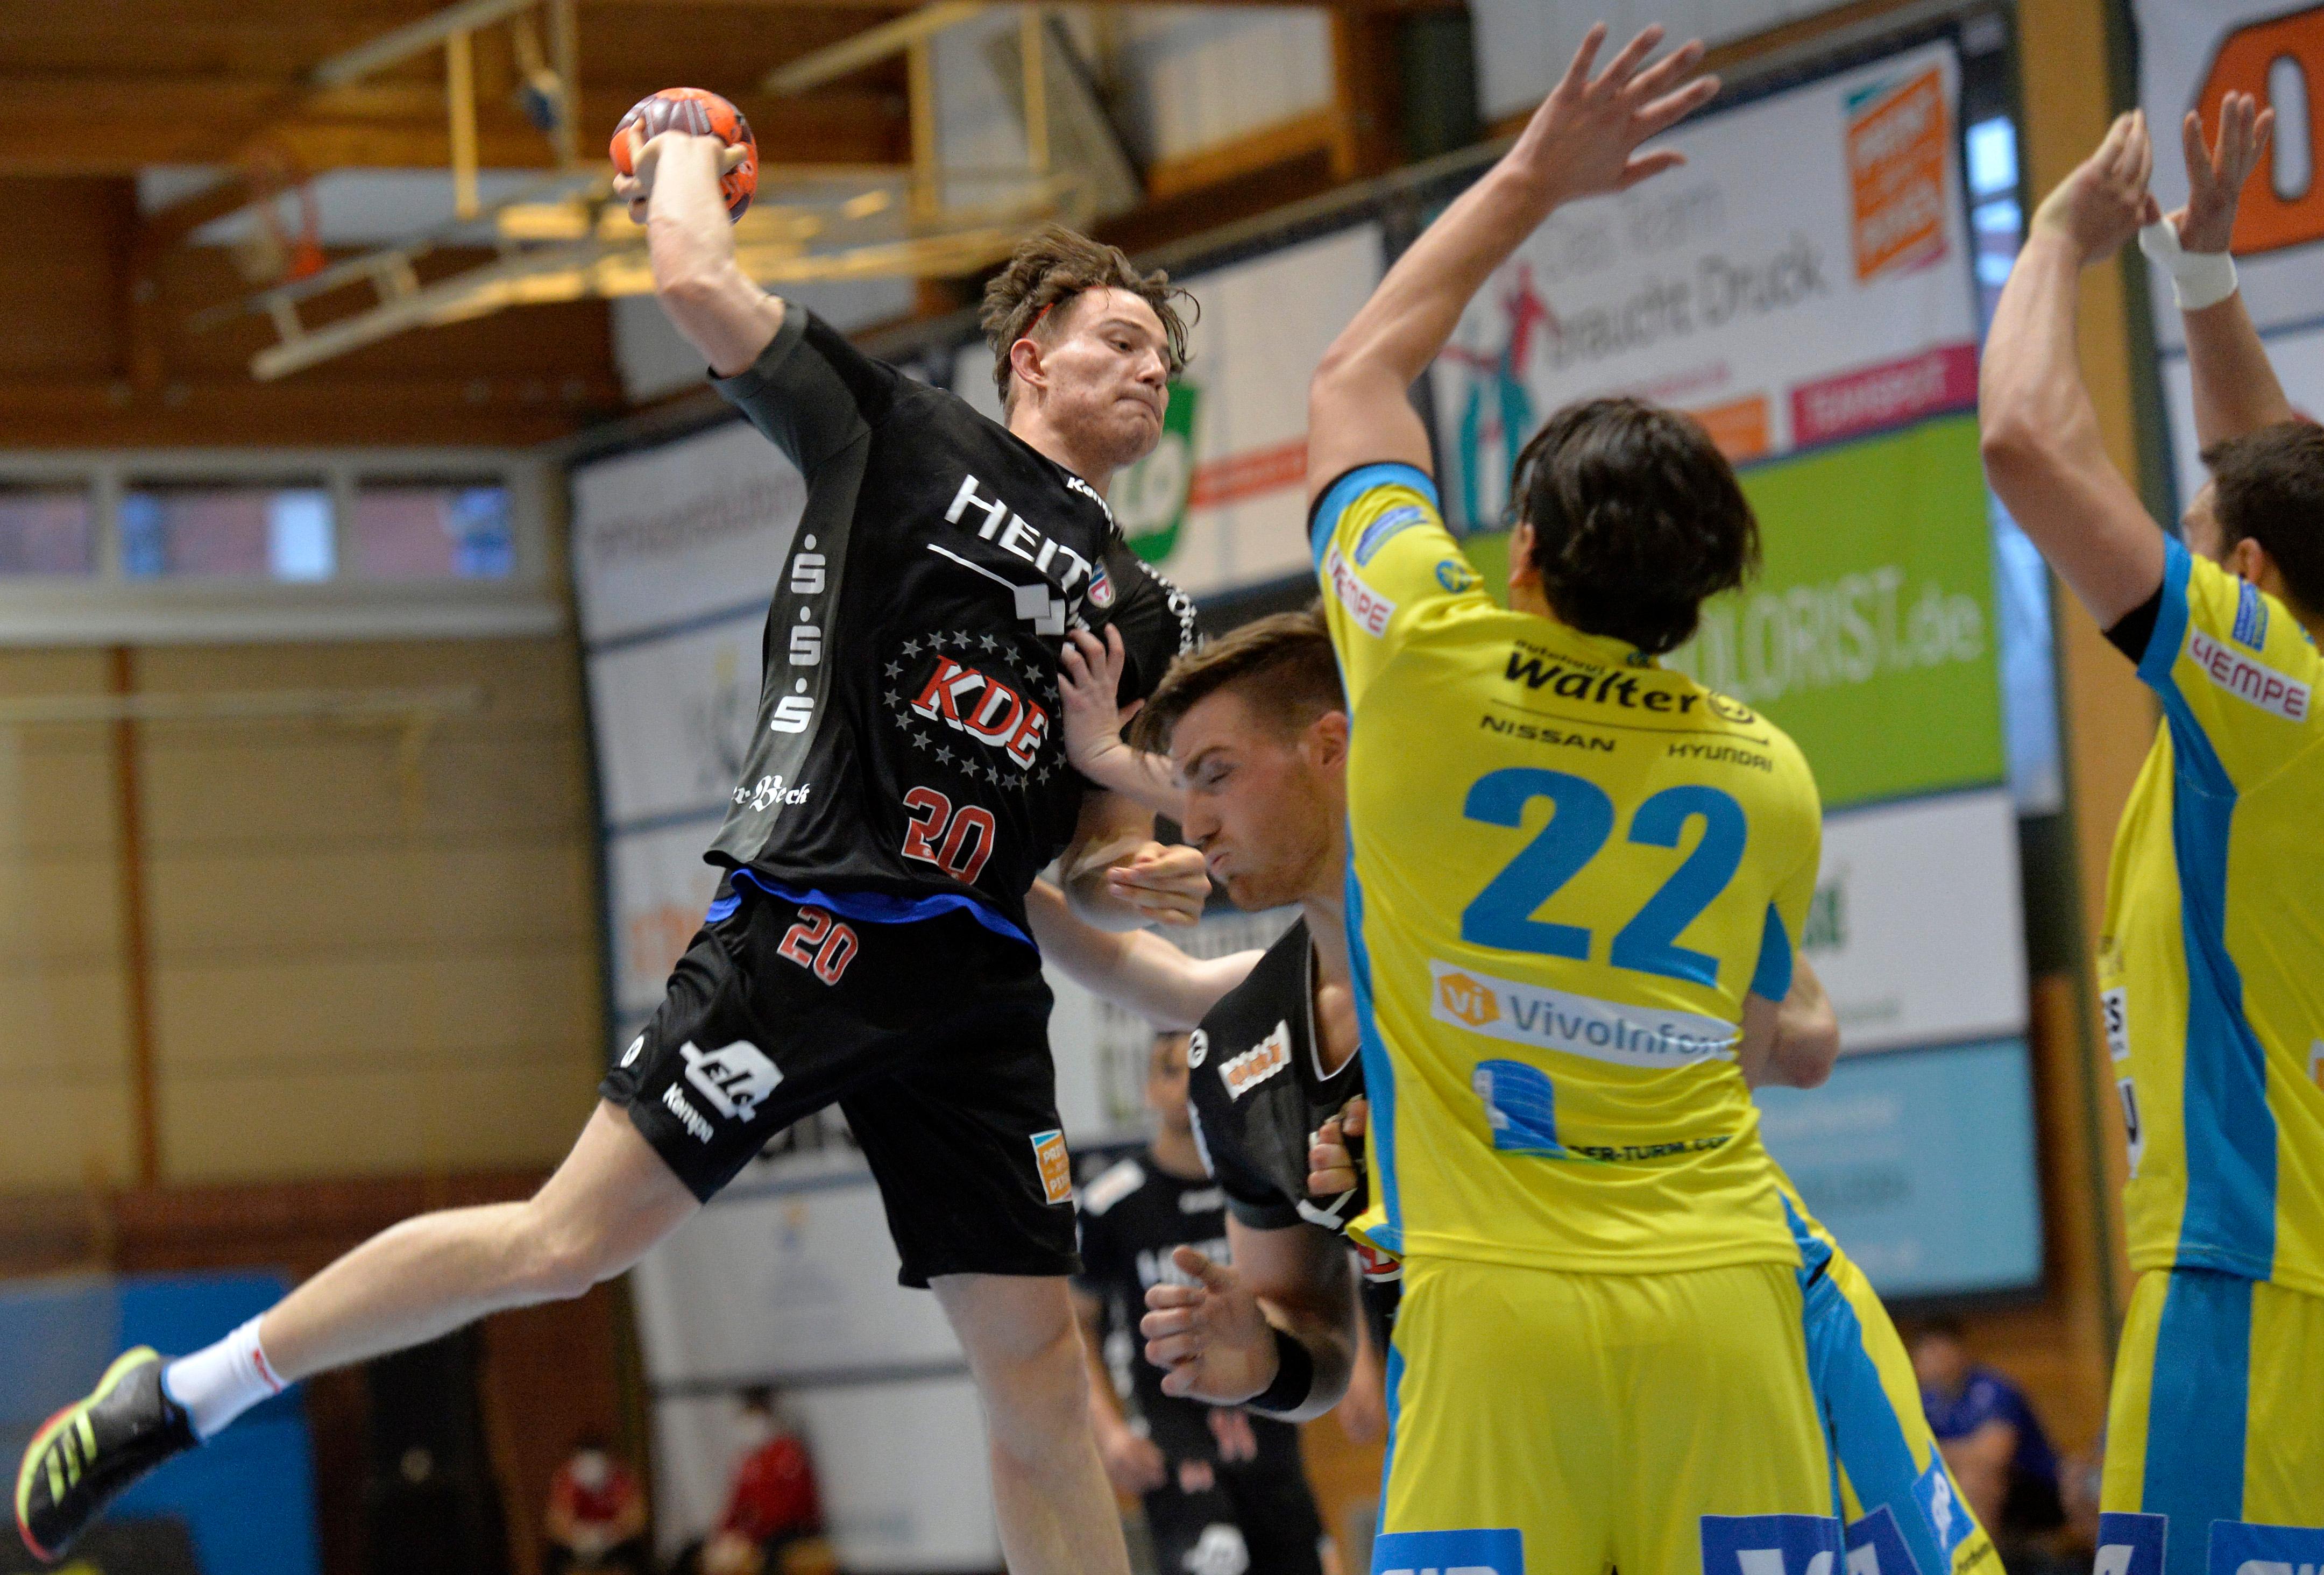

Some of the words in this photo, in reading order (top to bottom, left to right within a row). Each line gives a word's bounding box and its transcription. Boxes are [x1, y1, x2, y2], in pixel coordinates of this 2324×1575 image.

[944, 474, 1092, 592] HEIT
[911, 655, 1049, 771] KDE
[1480, 715, 1616, 752] NISSAN
[1668, 743, 1773, 772] HYUNDAI
[902, 786, 995, 885] 20
[1460, 767, 1748, 989] 22
[776, 905, 859, 987] 20
[662, 1081, 714, 1145] Kempa
